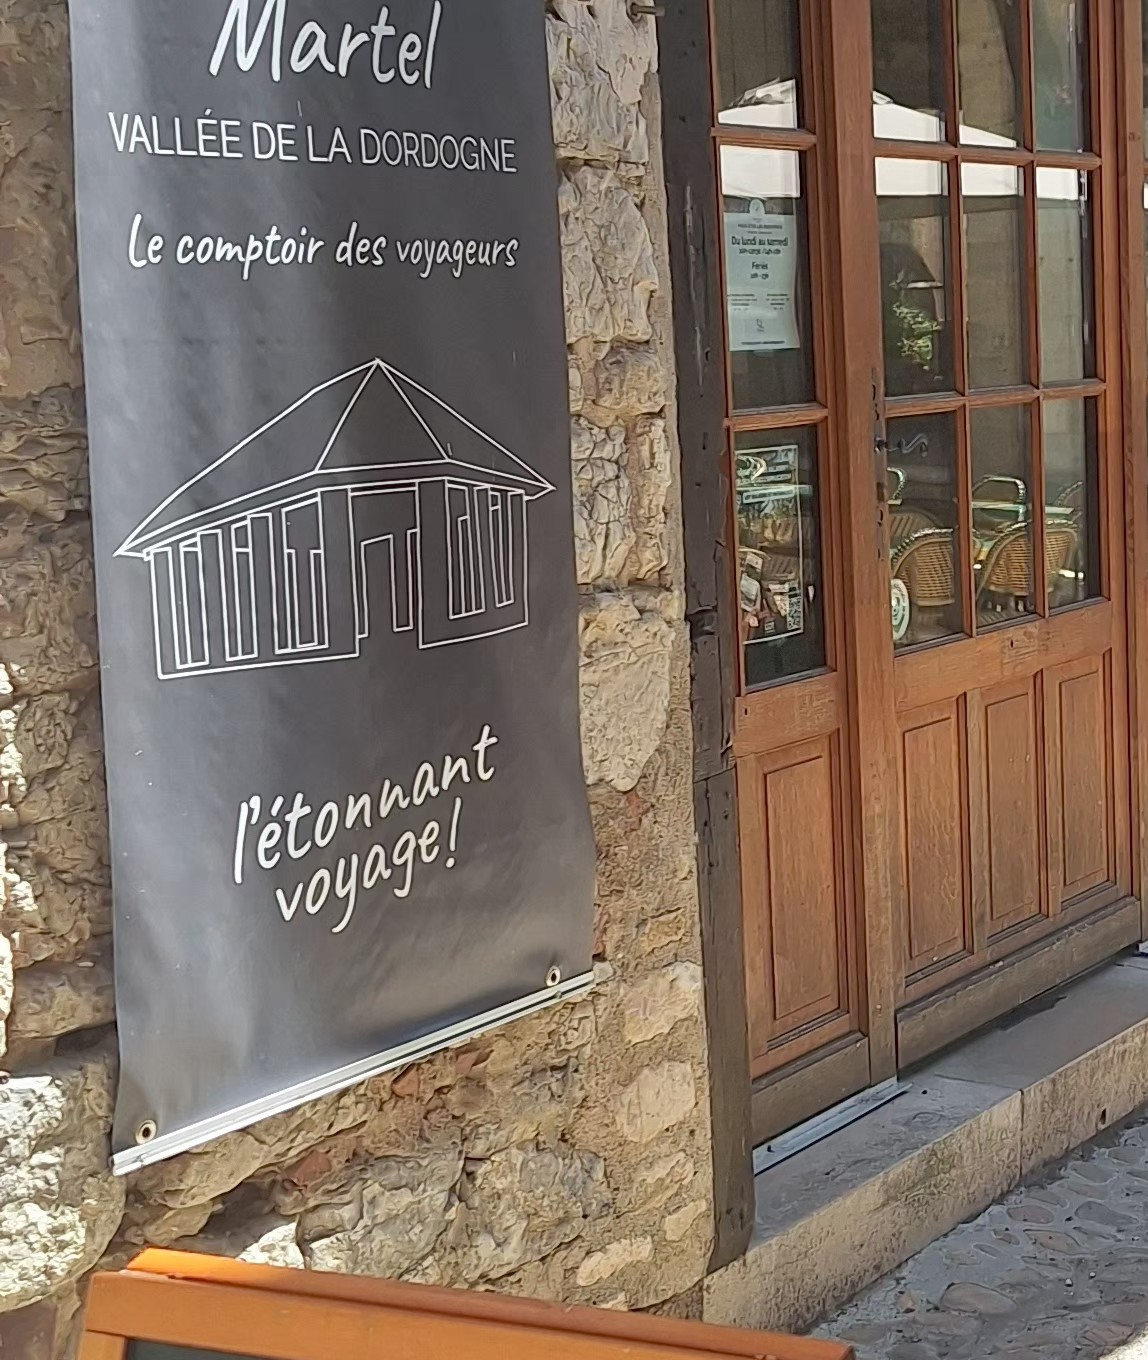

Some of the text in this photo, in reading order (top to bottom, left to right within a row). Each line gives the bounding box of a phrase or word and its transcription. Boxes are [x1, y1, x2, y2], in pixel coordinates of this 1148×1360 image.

[107, 108, 518, 173] VALLÉE DE LA DORDOGNE
[128, 213, 520, 280] Le comptoir des voyageurs
[234, 724, 498, 884] l'étonnant
[275, 796, 462, 933] voyage!
